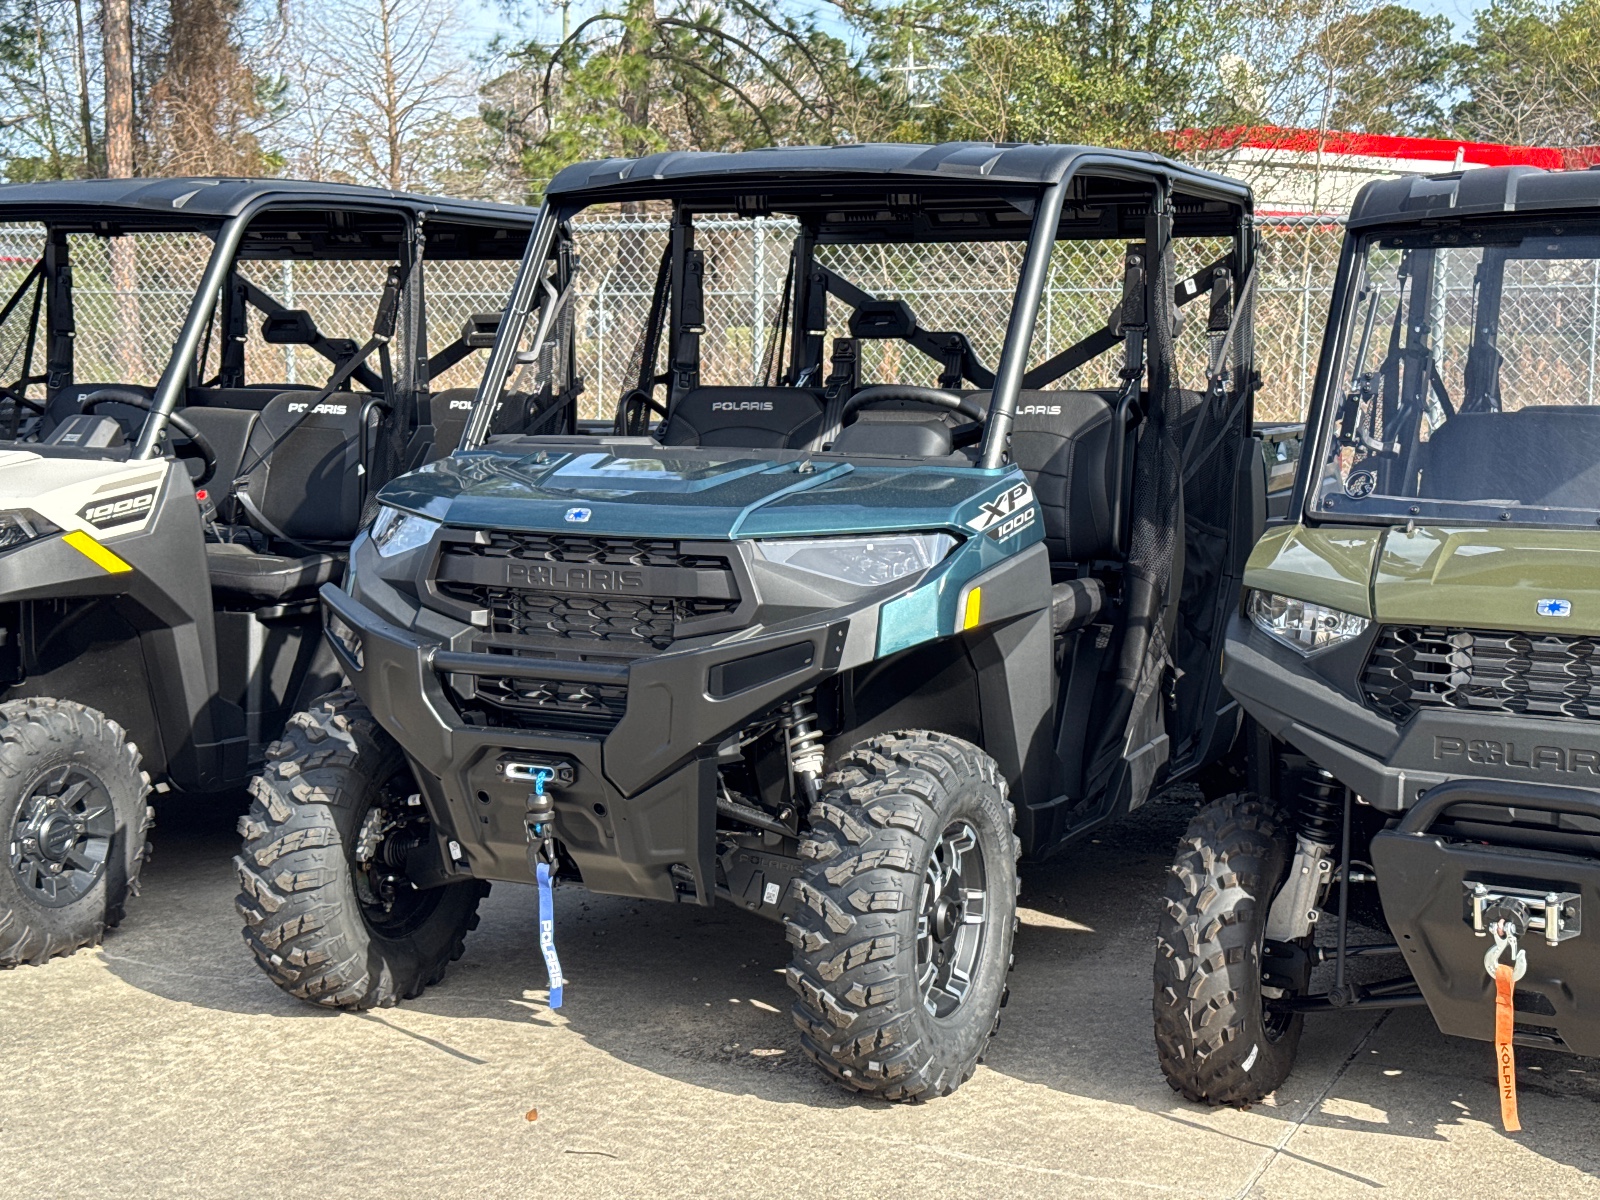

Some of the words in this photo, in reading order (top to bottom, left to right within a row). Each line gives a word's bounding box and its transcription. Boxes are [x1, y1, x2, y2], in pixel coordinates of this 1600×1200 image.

[712, 401, 774, 411] POLARIS
[1015, 405, 1062, 415] LARIS
[85, 493, 154, 520] 1000
[981, 483, 1028, 529] XP
[998, 507, 1035, 538] 1000
[506, 563, 644, 591] POLARIS
[541, 920, 562, 989] POLARIS
[1500, 1042, 1512, 1100] KOLPIN
